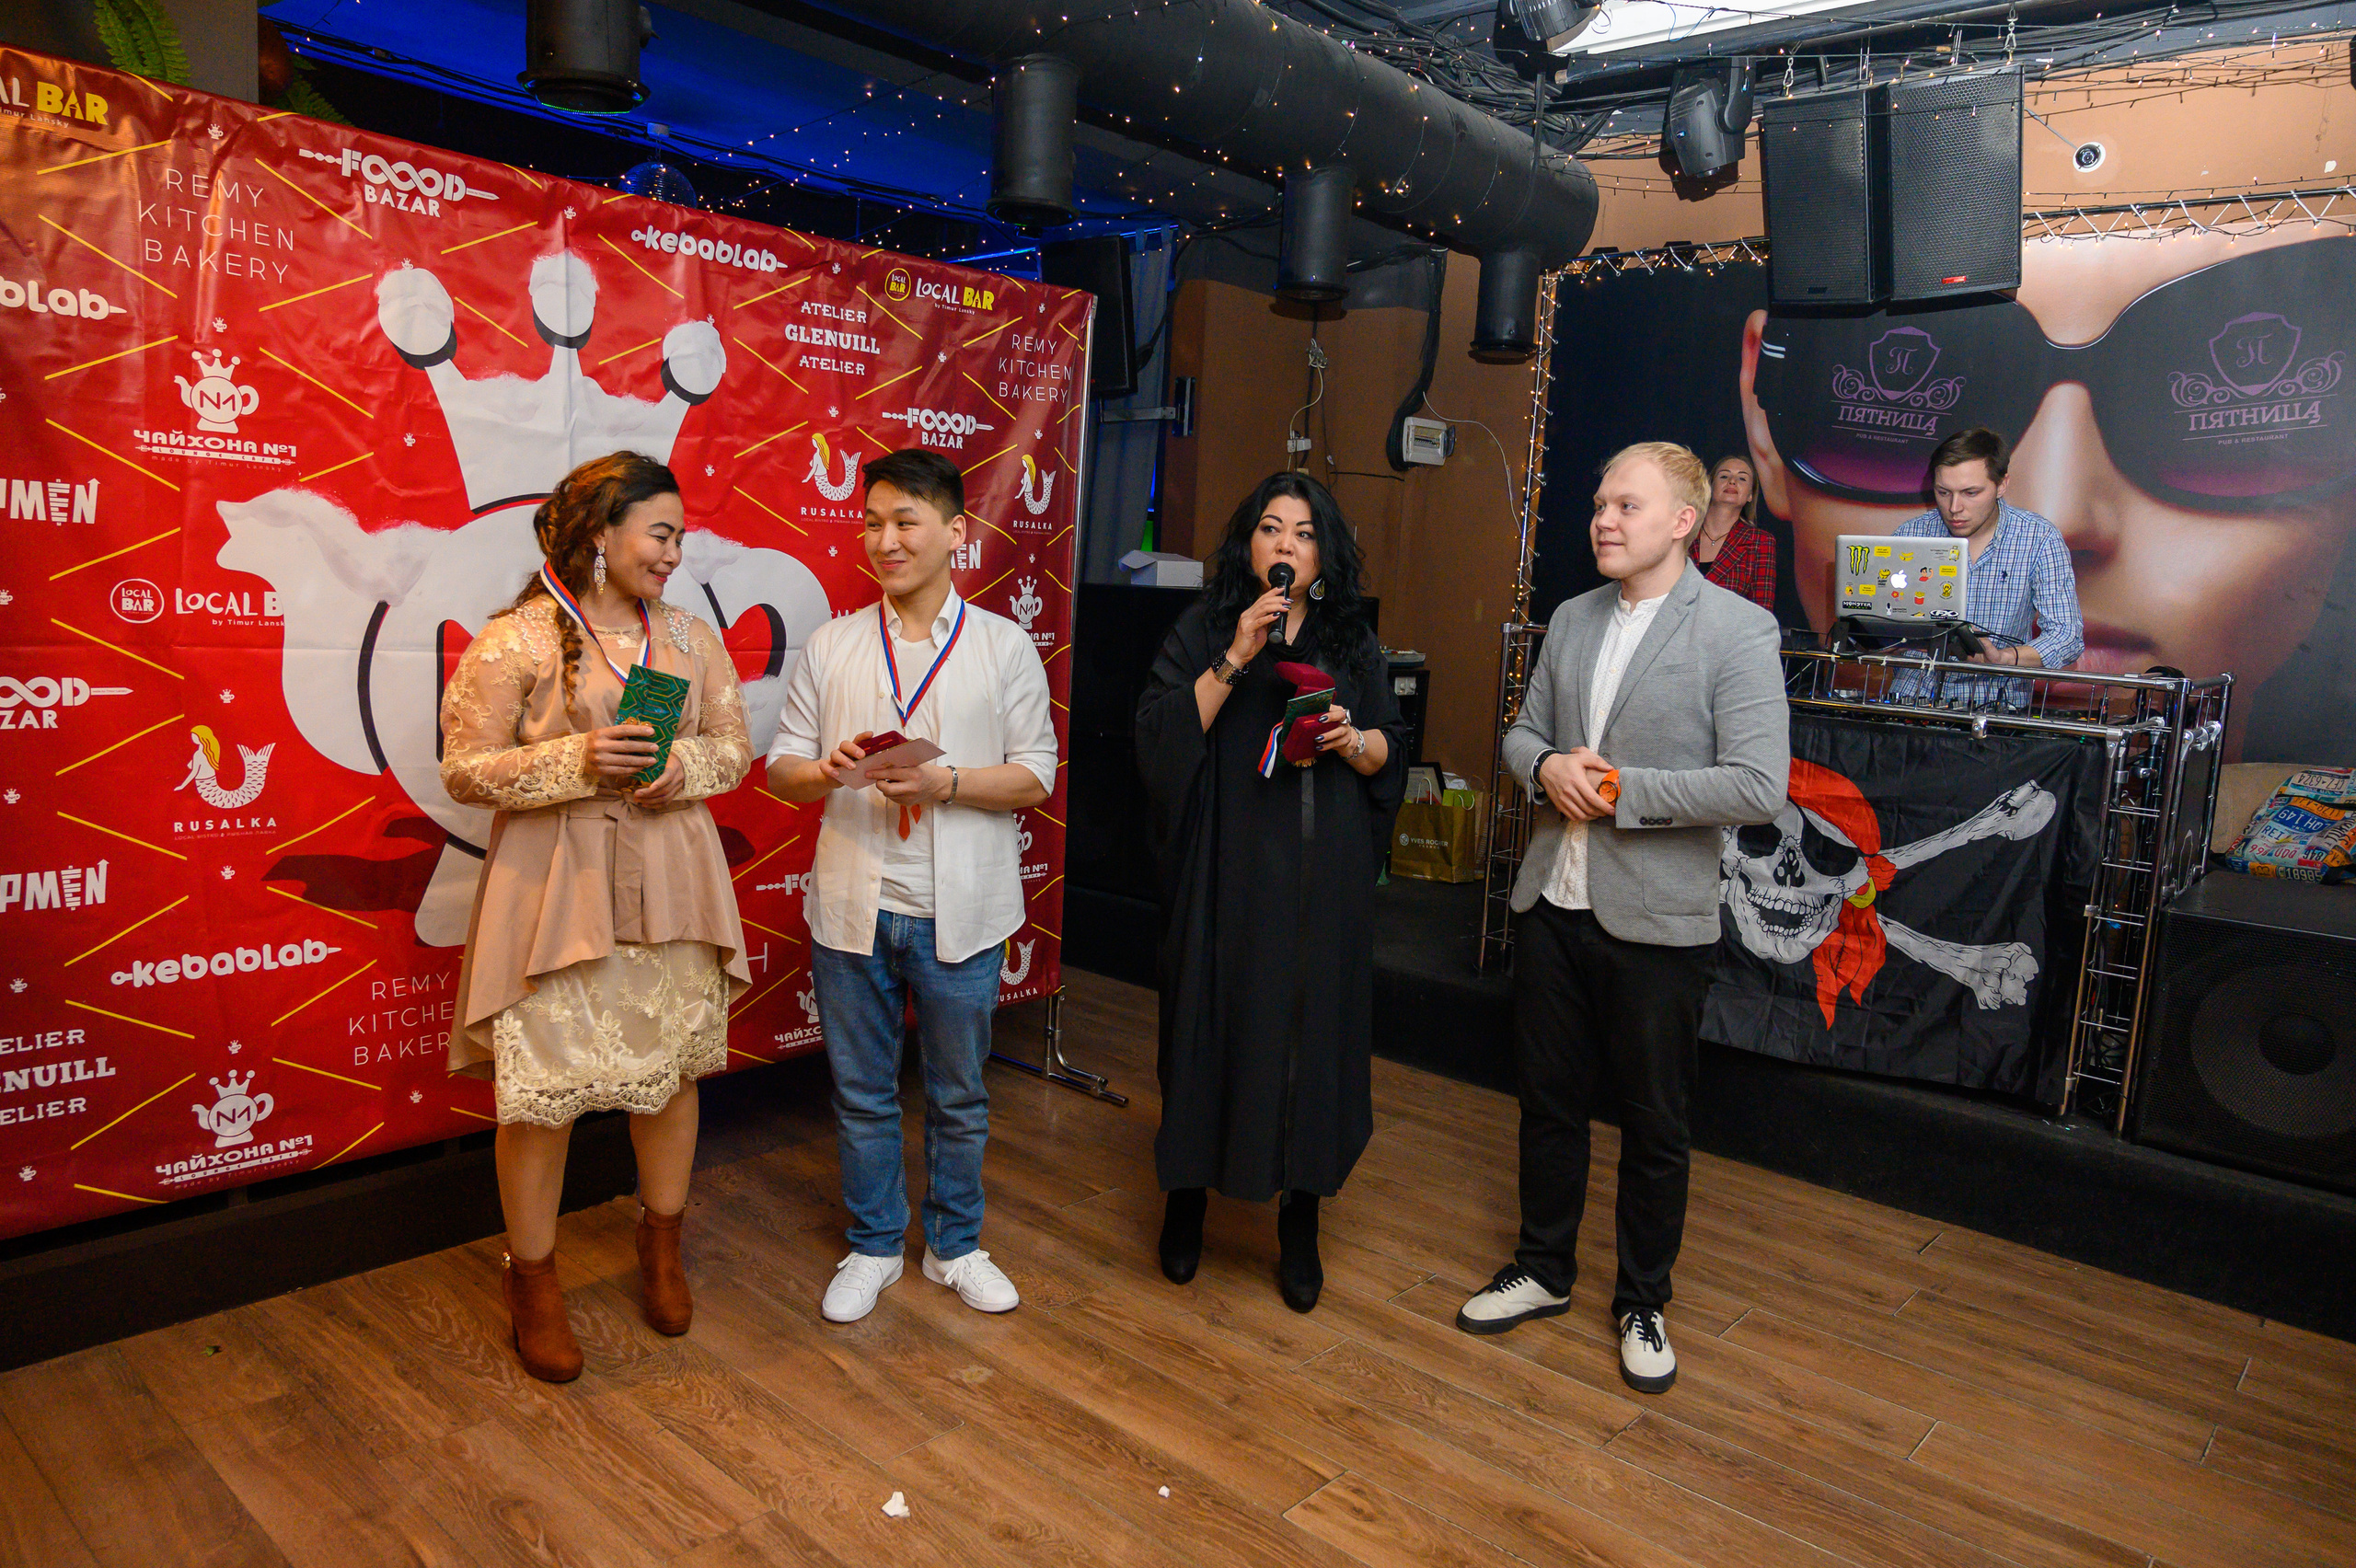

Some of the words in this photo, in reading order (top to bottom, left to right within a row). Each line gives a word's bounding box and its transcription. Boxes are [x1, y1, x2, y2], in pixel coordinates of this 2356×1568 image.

[37, 80, 109, 125] BAR
[29, 113, 70, 128] Lansky
[166, 168, 264, 208] REMY
[364, 184, 441, 218] BAZAR
[138, 199, 294, 251] KITCHEN
[145, 238, 290, 283] BAKERY
[889, 281, 907, 294] BAR
[891, 273, 907, 284] LOCAL
[916, 277, 960, 305] LOCAL
[963, 286, 995, 311] BAR
[800, 301, 867, 324] ATELIER
[941, 304, 957, 312] Timur
[958, 307, 976, 316] Lansky
[784, 324, 881, 355] GLENUILL
[1011, 333, 1057, 355] REMY
[798, 355, 866, 376] ATELIER
[998, 357, 1072, 381] KITCHEN
[999, 382, 1068, 404] BAKERY
[1837, 406, 1939, 436] ПЯТНИЦА
[2189, 400, 2322, 432] ПЯТНИЦА
[133, 429, 258, 454] ЧАЙХОНА
[263, 443, 297, 457] №1
[921, 431, 964, 449] BAZAR
[1873, 435, 1909, 444] RESTAURANT
[2241, 433, 2289, 444] RESTAURANT
[151, 455, 180, 463] made
[208, 460, 239, 468] Timur
[246, 464, 283, 473] Lansky
[801, 506, 863, 519] RUSALKA
[1012, 520, 1053, 530] RUSALKA
[121, 587, 154, 599] LOCAL
[175, 587, 259, 617] LOCAL
[121, 597, 155, 612] BAR
[212, 618, 224, 627] by
[173, 817, 277, 833] RUSALKA
[2261, 824, 2286, 841] REI
[372, 971, 450, 1001] REMY
[349, 1000, 454, 1036] KITCHE
[354, 1032, 450, 1066] BAKER
[155, 1143, 274, 1176] ЧАЙХОНА
[279, 1134, 314, 1152] №1
